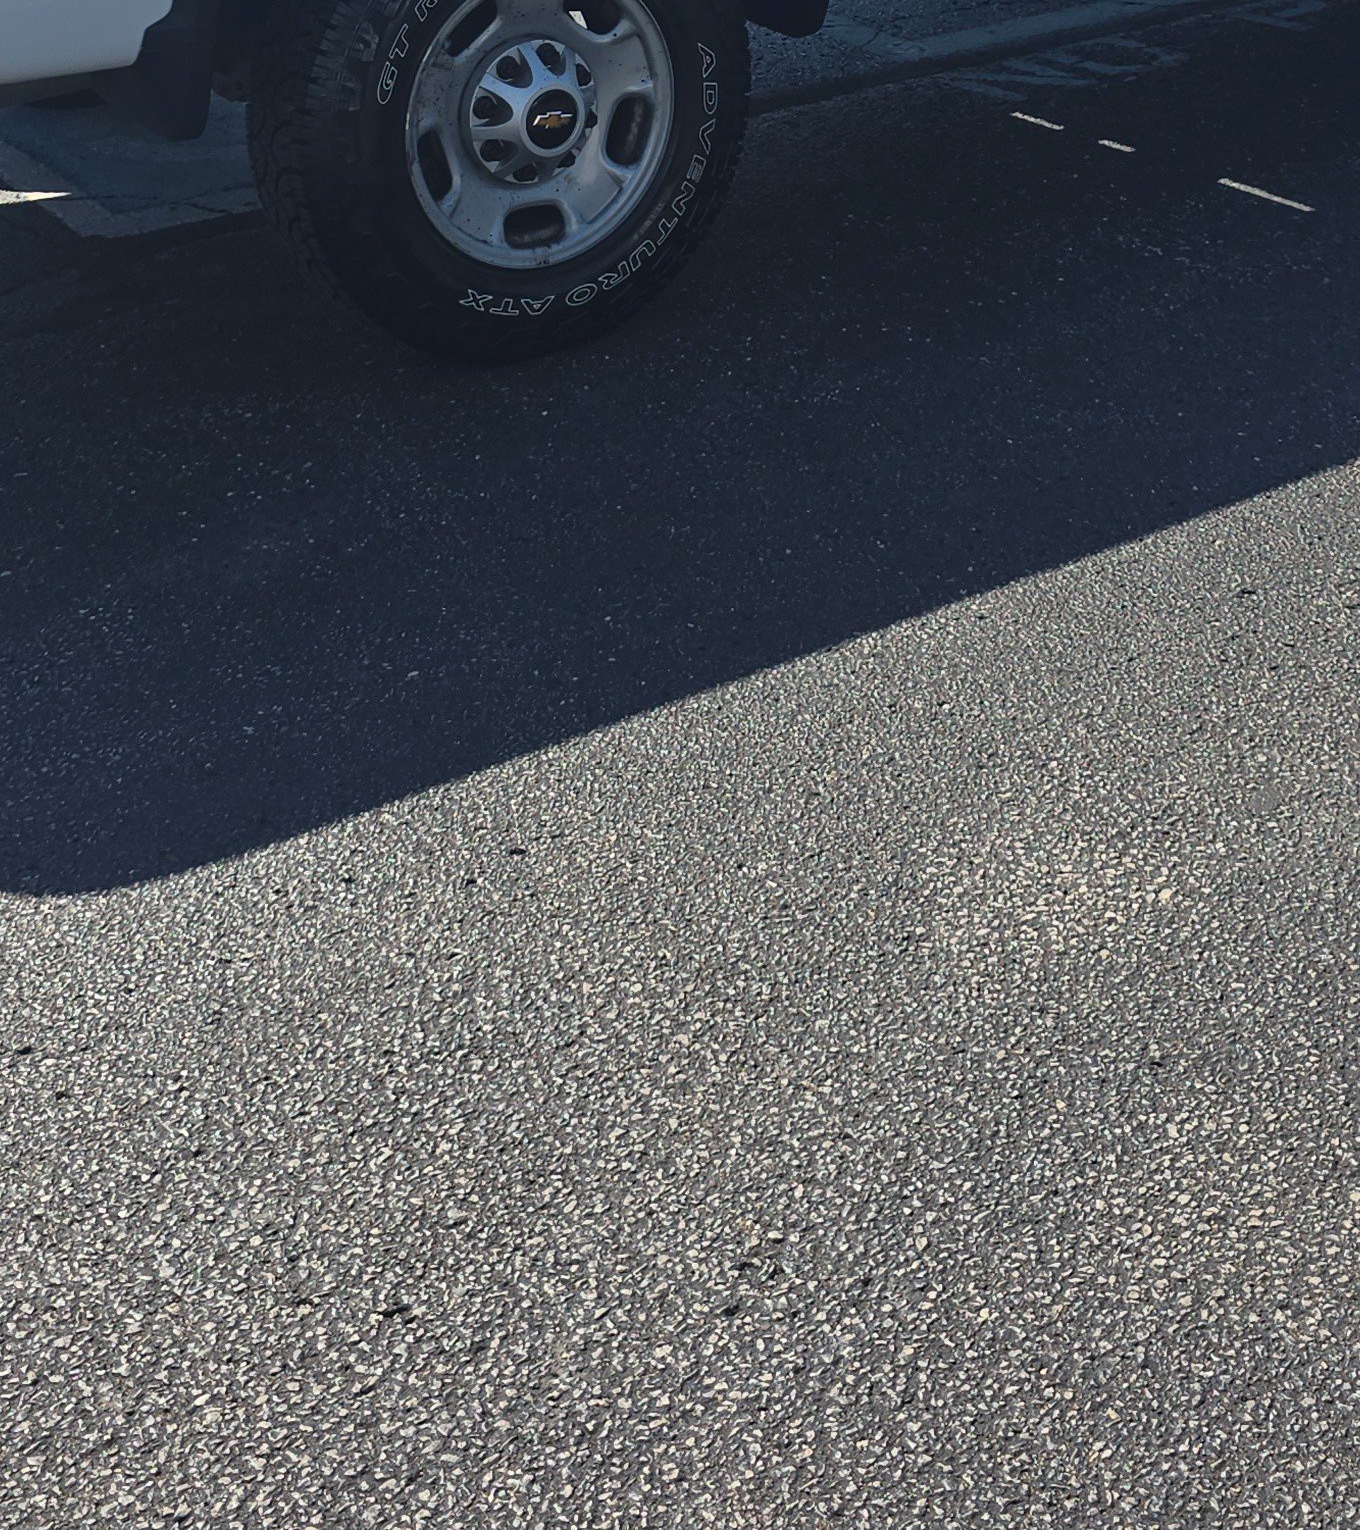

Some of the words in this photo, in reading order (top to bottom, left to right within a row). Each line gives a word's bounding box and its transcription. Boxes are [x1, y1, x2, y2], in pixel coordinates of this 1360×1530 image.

[376, 22, 410, 105] GT
[935, 33, 1189, 101] NO
[565, 42, 719, 306] ADVENTURO
[458, 288, 556, 316] ATX
